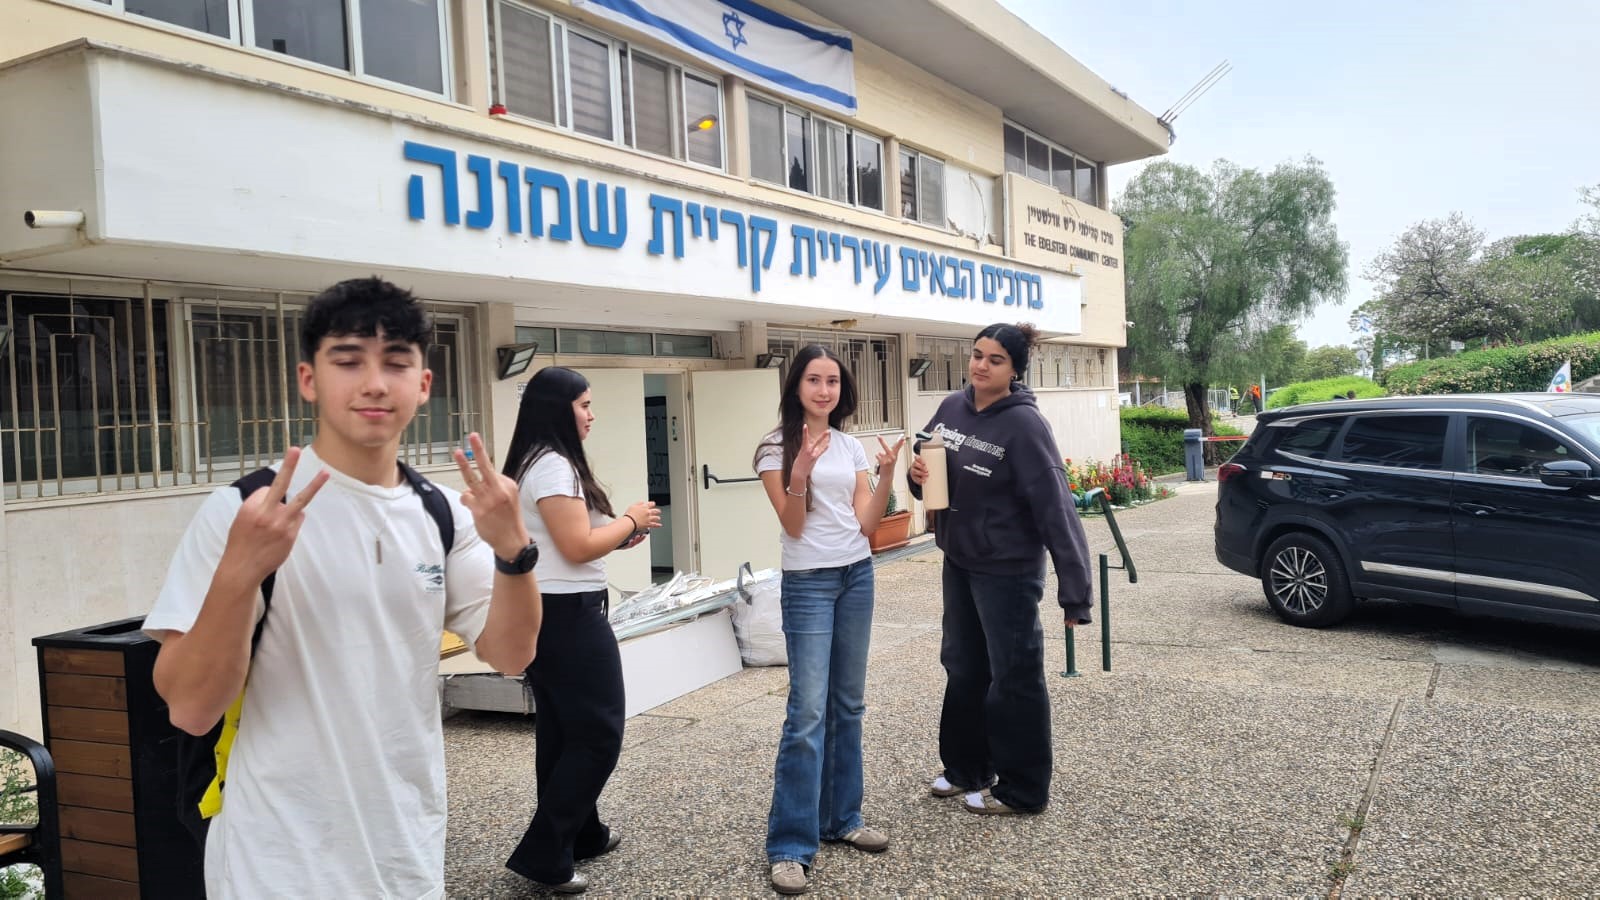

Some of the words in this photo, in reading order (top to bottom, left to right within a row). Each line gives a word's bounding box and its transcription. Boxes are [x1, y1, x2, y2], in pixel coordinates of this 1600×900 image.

[403, 140, 628, 249] שמונה
[647, 193, 777, 293] קריית
[790, 224, 891, 295] עיריית
[899, 246, 976, 300] הבאים
[1024, 232, 1036, 247] THE
[1038, 236, 1067, 256] EDELSTEIN
[1069, 245, 1099, 264] COMMUNITY
[1101, 254, 1119, 269] CENTER
[981, 264, 1043, 310] ברוכים
